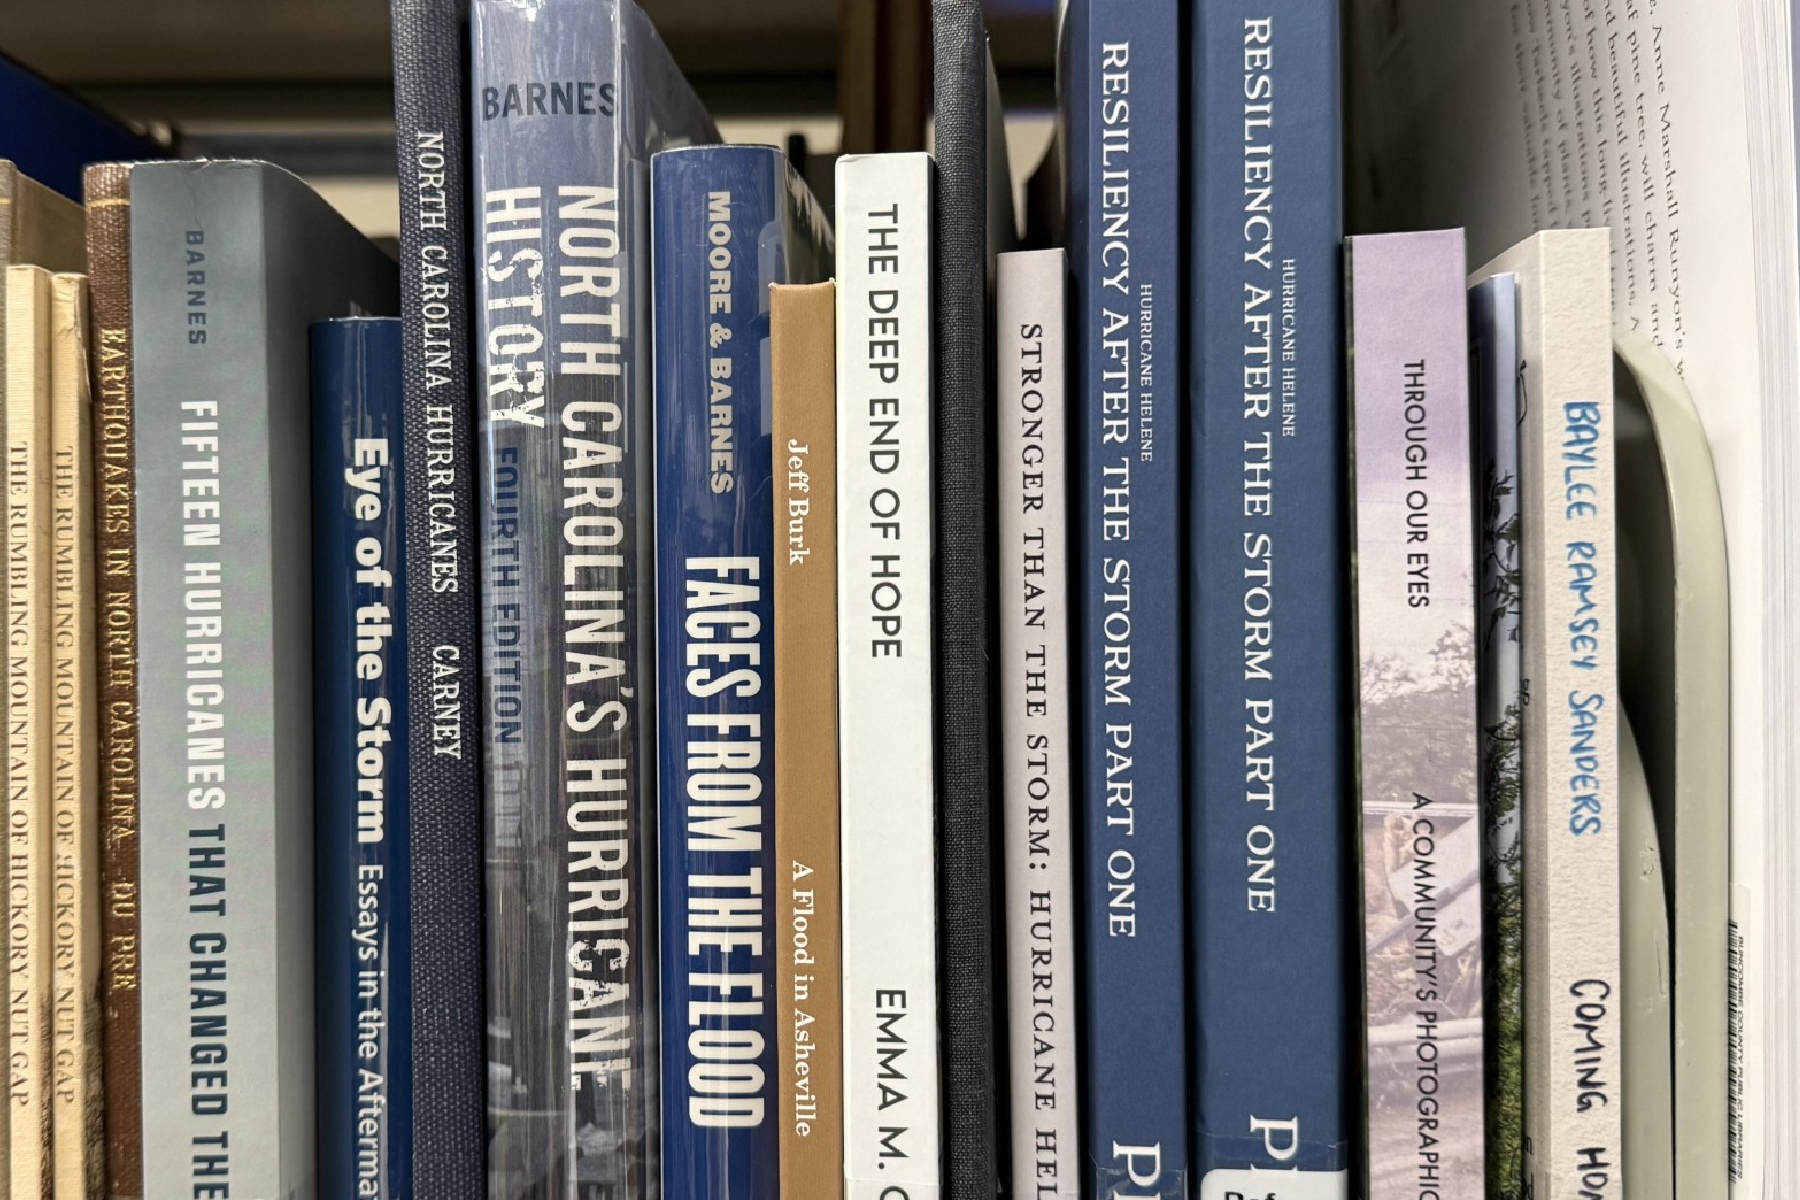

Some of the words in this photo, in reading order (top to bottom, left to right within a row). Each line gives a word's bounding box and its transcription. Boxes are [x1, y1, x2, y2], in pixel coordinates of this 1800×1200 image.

[482, 81, 620, 122] BARNES
[1586, 26, 1598, 80] how
[1592, 87, 1604, 135] this
[1607, 31, 1628, 146] beautiful
[1627, 30, 1641, 85] pine
[1651, 25, 1667, 95] Anne
[1101, 41, 1131, 295] RESILIENCY
[1243, 16, 1274, 269] RESILIENCY
[1636, 92, 1646, 148] tree,
[1660, 101, 1679, 221] Marshall
[417, 130, 447, 231] NORTH
[1641, 153, 1655, 202] will
[186, 229, 207, 345] BARNES
[557, 185, 621, 375] NORTH
[707, 191, 732, 314] MOORE
[868, 203, 899, 274] THE
[1645, 211, 1658, 293] charm
[1668, 227, 1686, 349] Runyon's
[421, 244, 451, 391] CAROLINA
[485, 186, 545, 429] HISTORY
[709, 322, 732, 348] &
[868, 289, 900, 383] DEEP
[1139, 283, 1153, 386] HURRICANE
[1243, 282, 1273, 419] AFTER
[1282, 258, 1296, 361] HURRICANE
[1650, 303, 1663, 347] and
[709, 357, 734, 494] BARNES
[1020, 323, 1044, 514] STRONGER
[1102, 307, 1131, 444] AFTER
[1140, 392, 1153, 461] HELENE
[1282, 367, 1296, 437] HELENE
[1404, 359, 1427, 480] THROUGH
[9, 441, 29, 495] THE
[55, 446, 75, 499] THE
[100, 327, 130, 532] EARTHQUAKES
[181, 400, 221, 547] FIFTEEN
[344, 438, 389, 521] Eye
[787, 438, 809, 493] Jeff
[869, 397, 900, 474] END
[1243, 431, 1273, 516] THE
[1563, 401, 1601, 520] BAYLEE
[426, 404, 459, 594] HURRICANES
[491, 446, 520, 587] FOURTH
[788, 496, 811, 565] Burk
[870, 487, 901, 540] OF
[1103, 458, 1131, 541] THE
[1406, 490, 1429, 544] OUR
[9, 503, 29, 647] RUMBLING
[54, 507, 75, 648] RUMBLING
[105, 547, 131, 578] IN
[356, 537, 393, 588] of
[562, 401, 634, 732] CAROLINA'S
[871, 554, 902, 657] HOPE
[1023, 527, 1046, 630] THAN
[1243, 532, 1273, 681] STORM
[1407, 553, 1430, 608] EYES
[1568, 540, 1600, 670] RAMSEY
[106, 591, 134, 687] NORTH
[356, 602, 393, 680] the
[492, 604, 522, 745] EDITION
[684, 556, 762, 698] FACES
[1103, 557, 1132, 705] STORM
[9, 655, 29, 802] MOUNTAIN
[54, 657, 75, 801] MOUNTAIN
[184, 562, 227, 809] HURRICANES
[432, 644, 462, 760] CARNEY
[1025, 645, 1047, 719] THE
[108, 701, 137, 844] CAROLINA
[356, 697, 392, 844] Storm
[687, 713, 763, 852] FROM
[1027, 734, 1050, 870] STORM:
[1105, 722, 1134, 835] PART
[1245, 698, 1274, 811] PART
[1411, 791, 1433, 810] A
[1568, 690, 1604, 836] SANDERS
[9, 809, 29, 845] OF
[55, 809, 75, 846] OF
[189, 823, 227, 918] THAT
[792, 860, 814, 882] A
[1247, 824, 1276, 913] ONE
[9, 853, 30, 979] HICKORY
[55, 854, 76, 979] HICKORY
[110, 881, 137, 919] DU
[351, 864, 384, 961] Essays
[566, 758, 631, 1092] HURRICANE
[688, 867, 763, 956] THE
[792, 889, 815, 965] Flood
[1107, 848, 1137, 937] ONE
[1412, 818, 1438, 1002] COMMUNITY'S
[55, 987, 76, 1041] NUT
[111, 934, 137, 992] PRE
[358, 970, 387, 998] in
[794, 974, 815, 1001] in
[1030, 889, 1056, 1110] HURRICANE
[9, 990, 30, 1042] NUT
[189, 931, 229, 1116] CHANGED
[358, 1007, 387, 1058] the
[688, 972, 766, 1127] FLOOD
[876, 989, 909, 1111] EMMA
[1569, 979, 1612, 1113] COMING
[9, 1051, 29, 1107] GAP
[55, 1049, 76, 1104] GAP
[794, 1009, 817, 1137] Asheville
[191, 1130, 231, 1200] THE
[878, 1126, 910, 1170] M.
